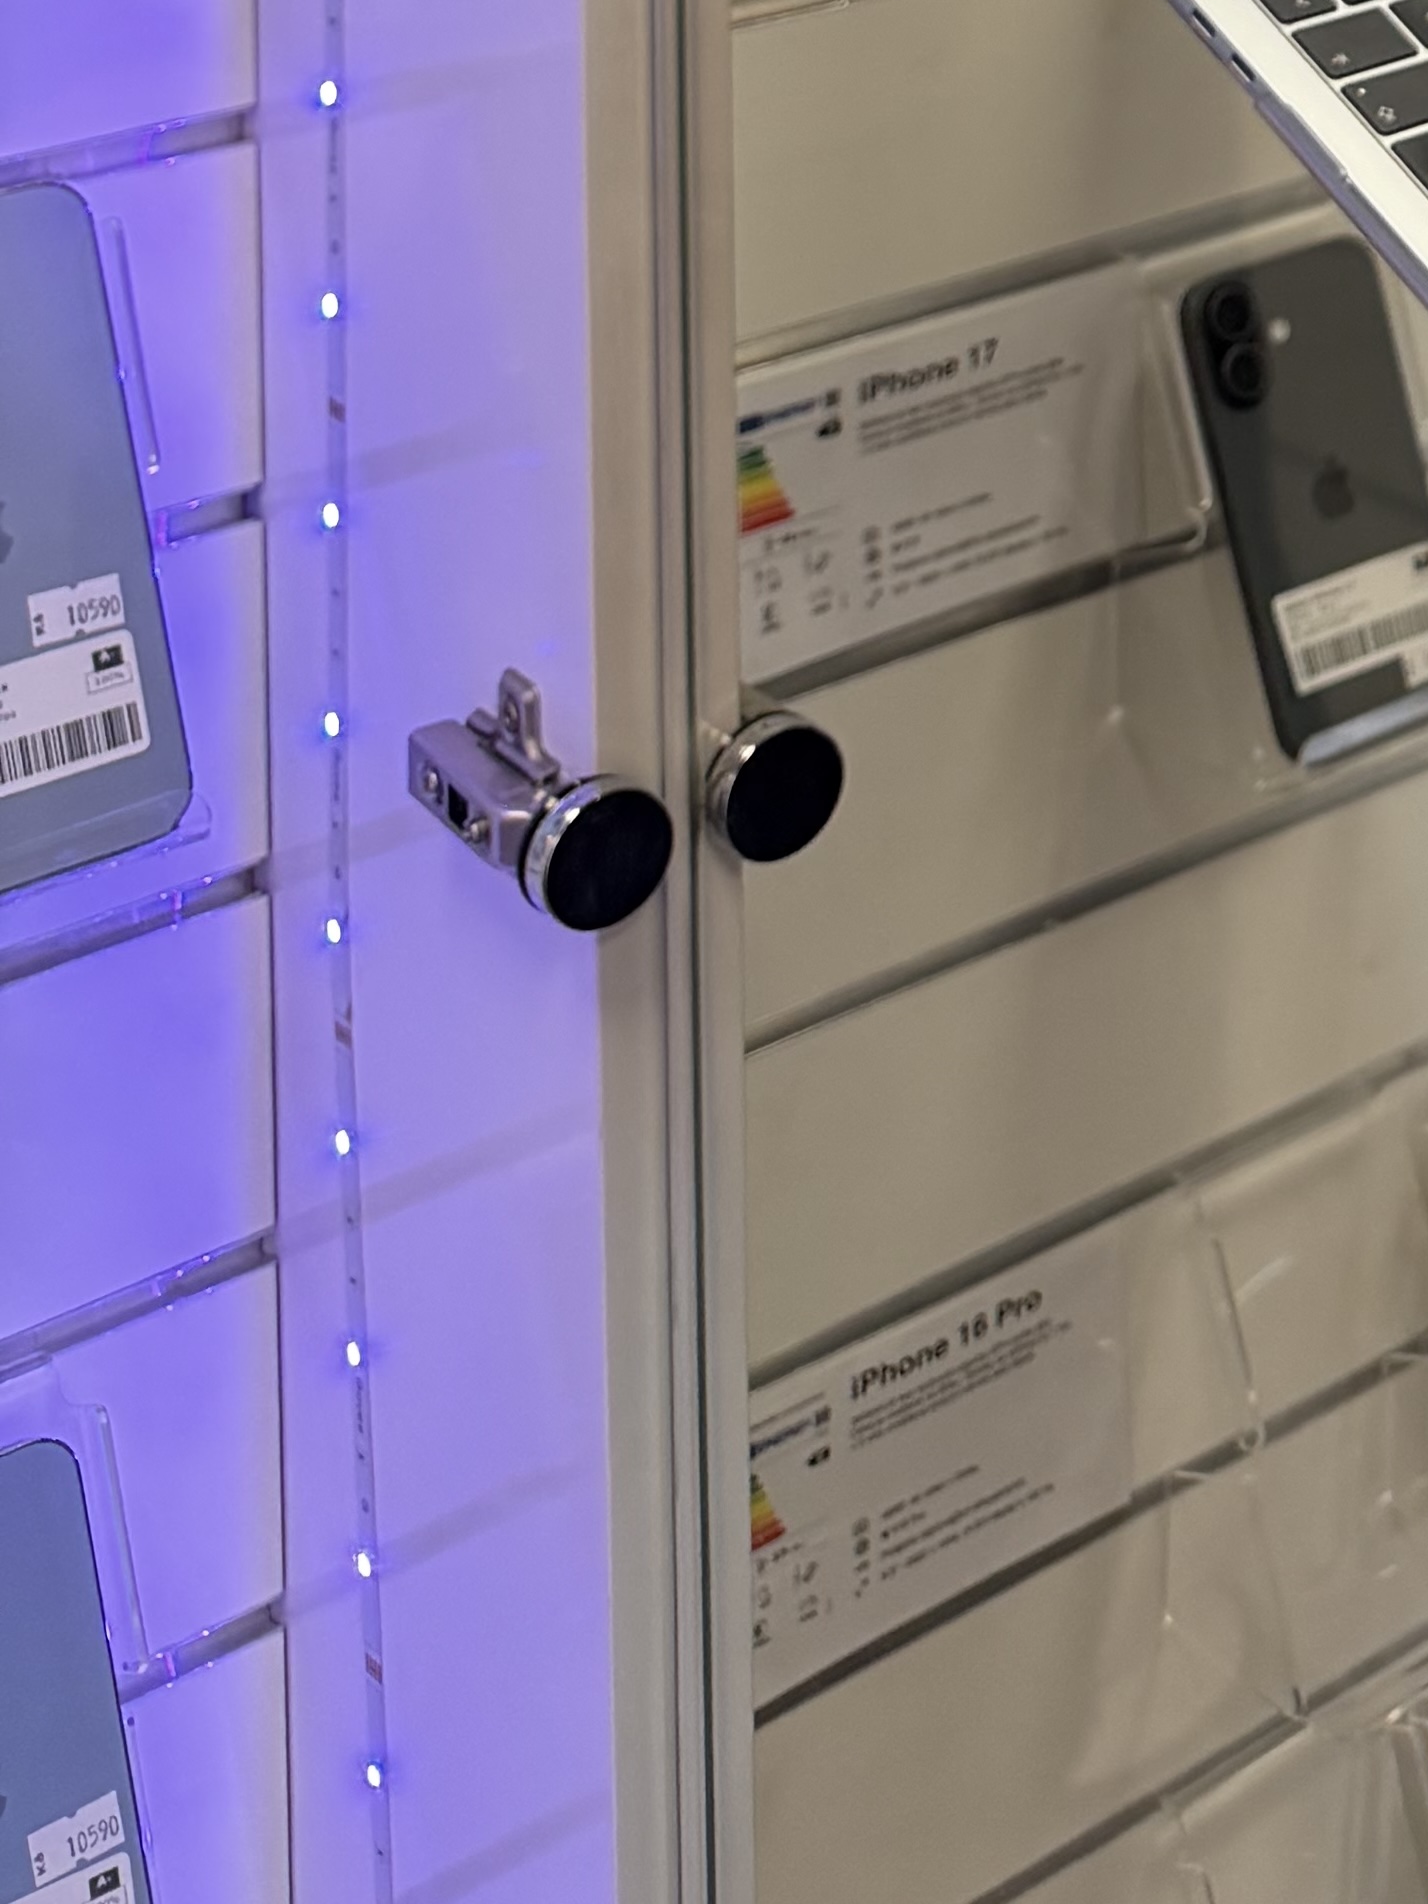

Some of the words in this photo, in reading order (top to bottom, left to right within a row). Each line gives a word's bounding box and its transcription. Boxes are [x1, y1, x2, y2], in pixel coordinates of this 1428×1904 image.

[858, 355, 960, 405] iPhone
[966, 336, 1000, 371] 17
[67, 593, 122, 627] 10590
[850, 1338, 950, 1401] iPhone
[958, 1311, 989, 1346] 16
[994, 1289, 1043, 1329] Pro
[66, 1814, 120, 1858] 10590
